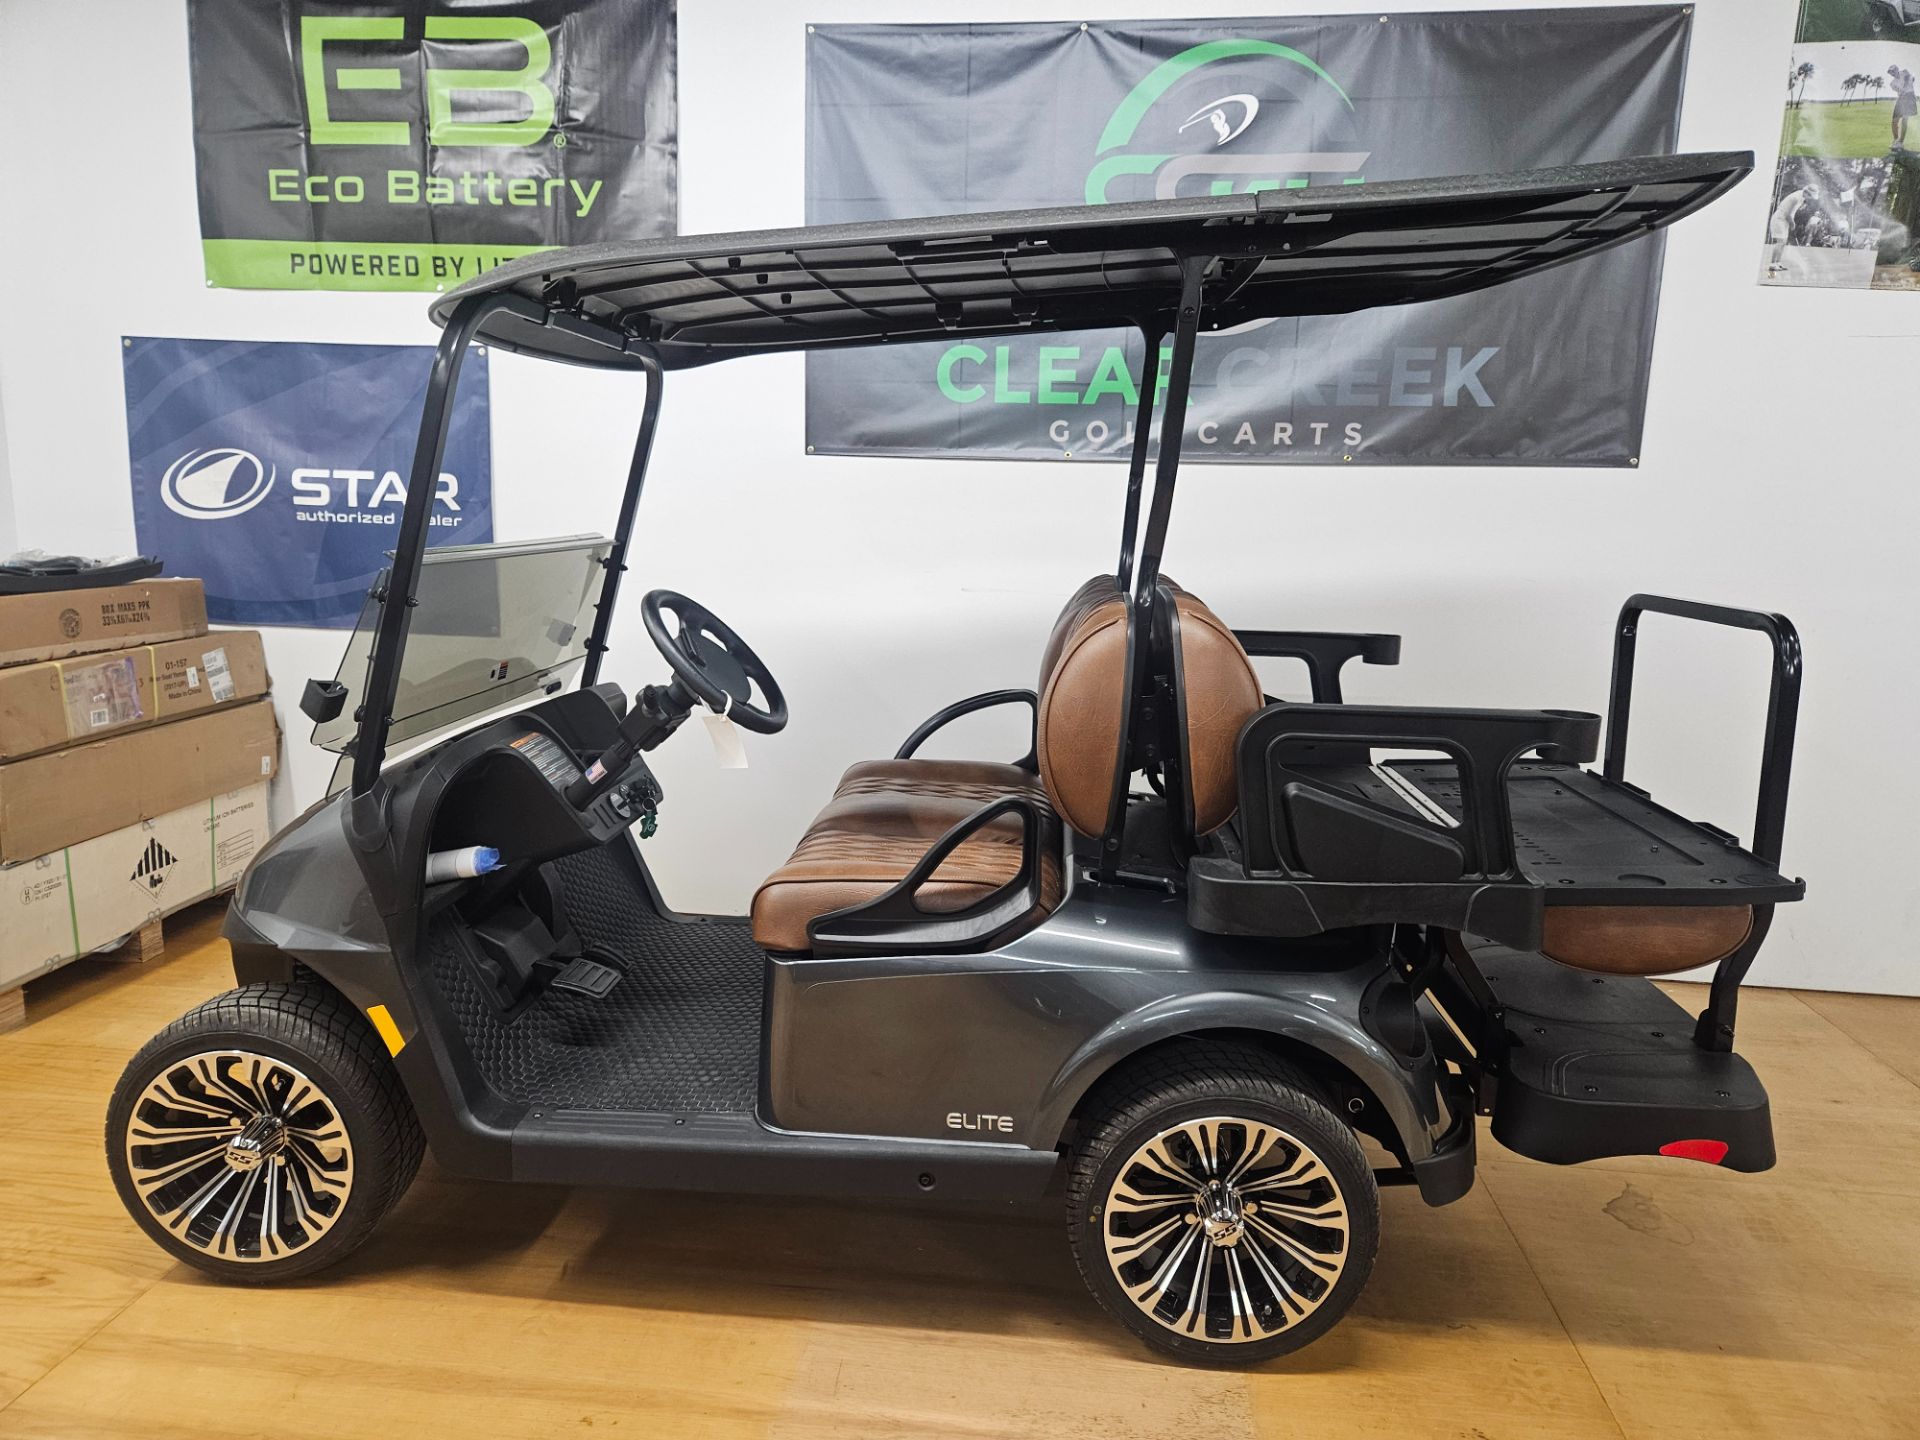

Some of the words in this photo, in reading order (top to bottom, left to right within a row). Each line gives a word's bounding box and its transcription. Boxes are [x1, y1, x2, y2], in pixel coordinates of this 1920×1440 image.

[268, 168, 365, 203] Eco
[387, 169, 603, 217] Battery
[290, 253, 420, 277] POWERED
[432, 255, 464, 278] BY
[1216, 345, 1499, 408] CREEK
[1049, 419, 1161, 444] GOL
[1197, 421, 1362, 446] CARTS
[291, 468, 462, 511] STAR
[296, 510, 395, 525] authorized
[946, 1112, 1014, 1133] ELITE
